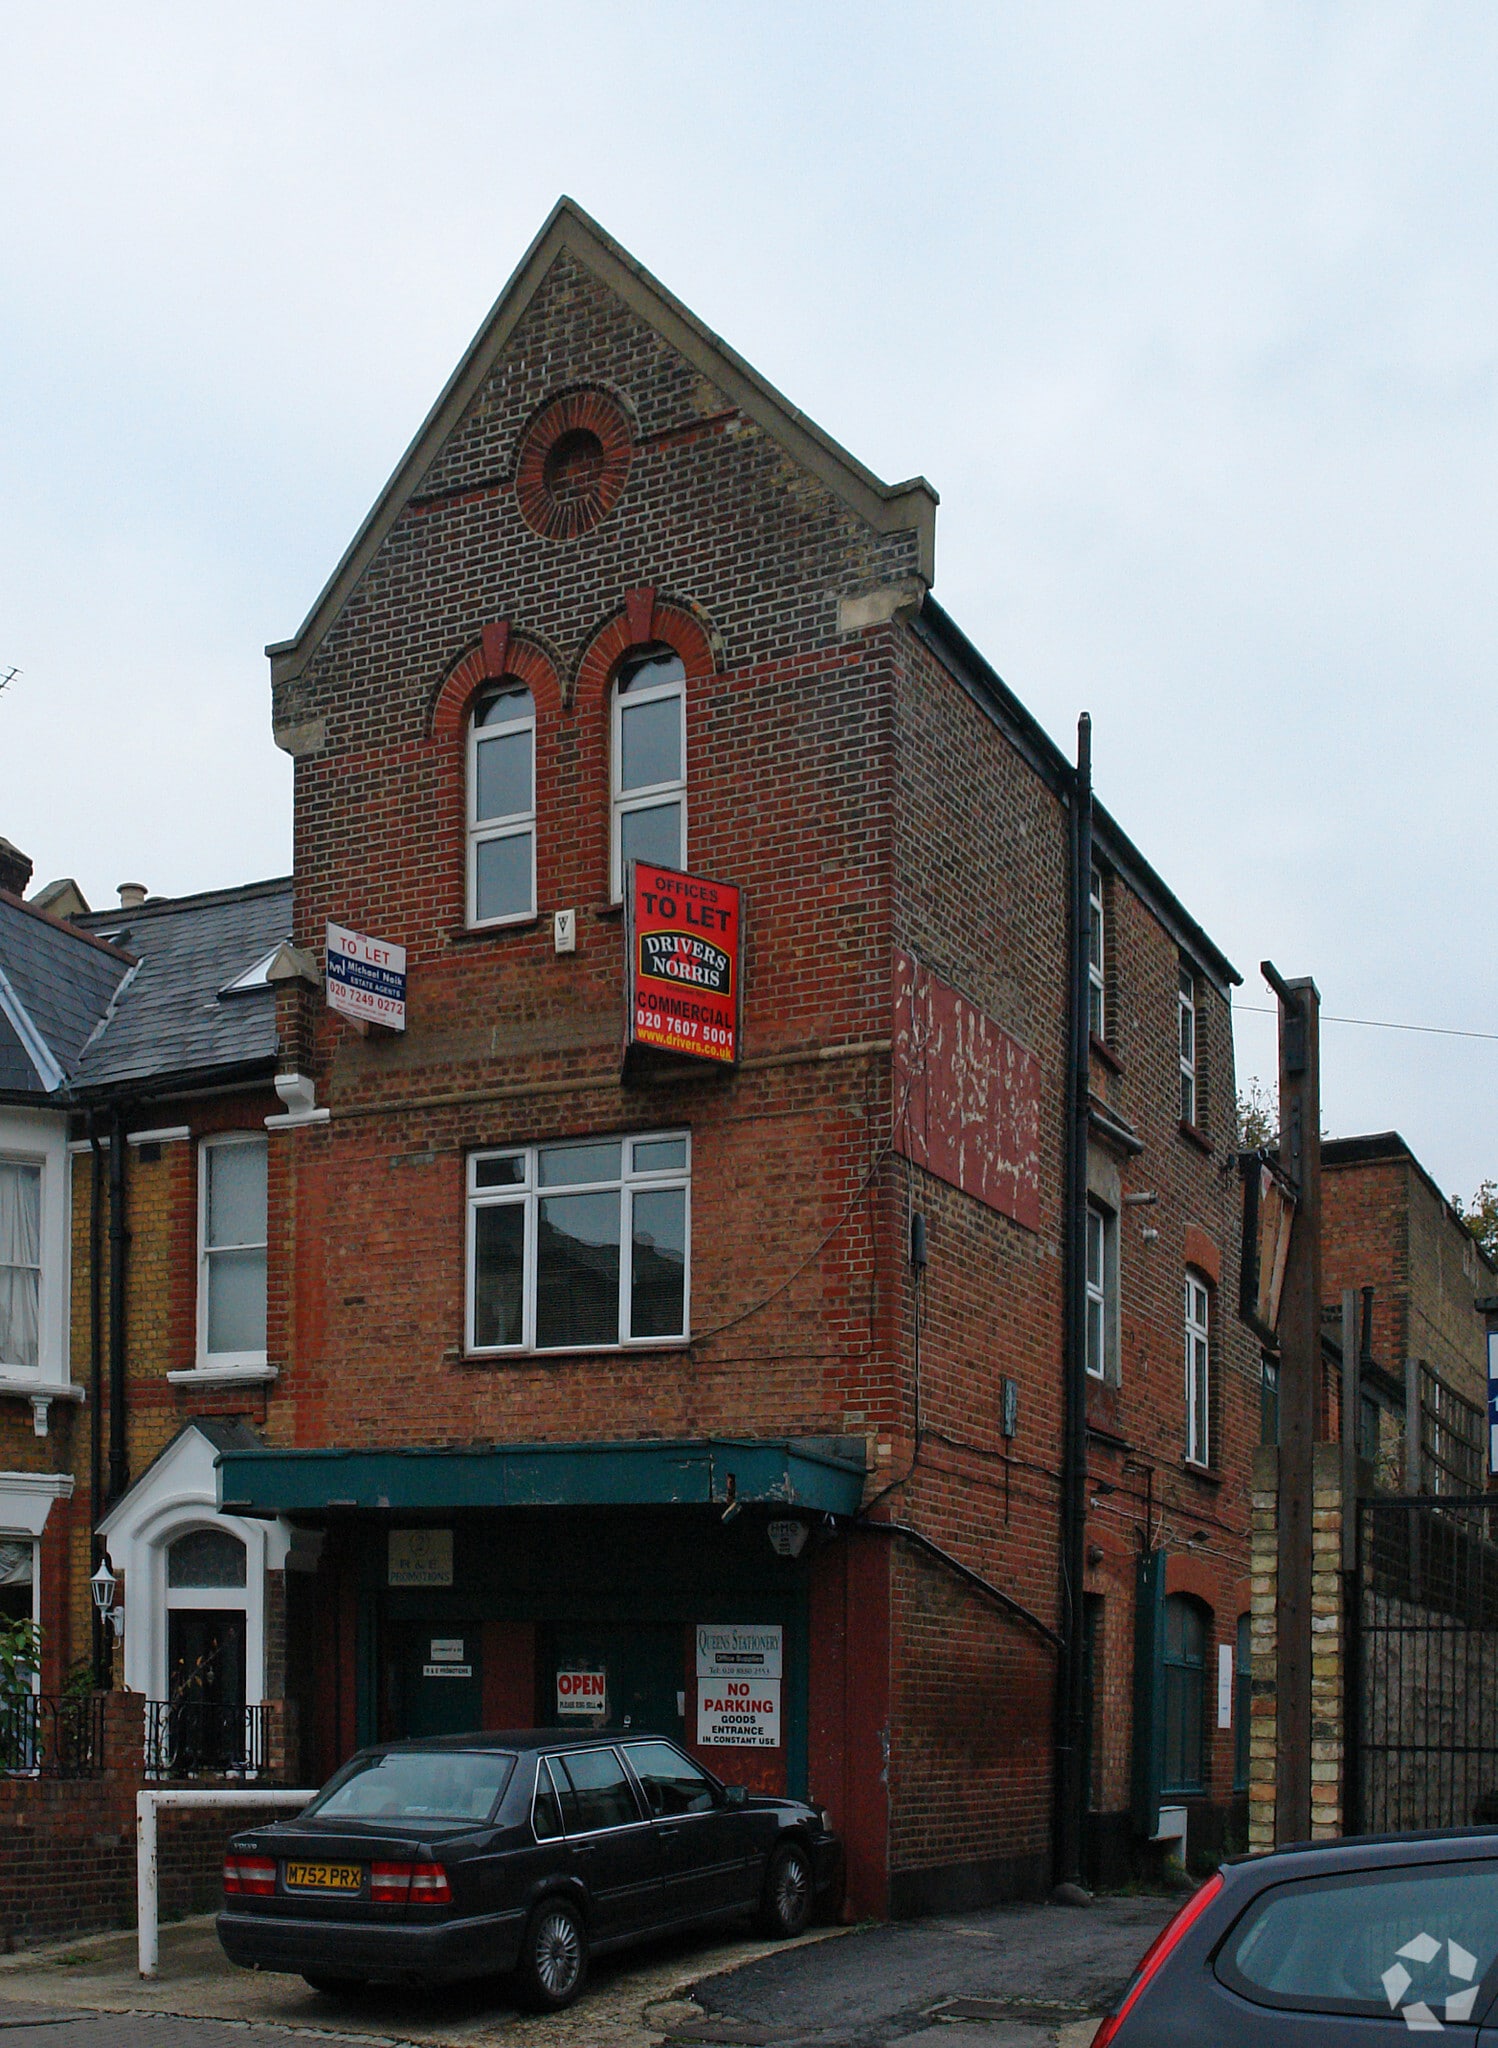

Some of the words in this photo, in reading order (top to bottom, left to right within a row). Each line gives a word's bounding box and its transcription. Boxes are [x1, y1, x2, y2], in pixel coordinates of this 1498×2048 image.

[655, 877, 718, 902] OFFICES
[641, 892, 677, 919] TO
[686, 901, 731, 931] LET
[340, 937, 357, 954] TO
[365, 946, 390, 965] LET
[645, 936, 726, 972] DRIVERS
[347, 961, 380, 979] Michael
[653, 955, 720, 987] NORRIS
[330, 981, 346, 997] 020
[349, 989, 374, 1006] 7249
[377, 998, 403, 1015] 0272
[350, 976, 374, 990] ESTATE
[374, 984, 401, 998] AGENTS
[637, 991, 732, 1029] COMMERCIAL
[637, 1010, 661, 1029] 020
[666, 1017, 698, 1037] 7607
[703, 1026, 732, 1046] 5001
[637, 1028, 732, 1059] www.drivers.co.uk
[732, 1629, 779, 1651] STATIONERY
[559, 1674, 604, 1695] OPEN
[728, 1683, 750, 1696] NO
[704, 1698, 773, 1713] PARKING
[712, 1725, 764, 1735] ENTRANCE
[721, 1715, 756, 1724] GOODS
[713, 1736, 757, 1744] CONSTANT
[759, 1737, 775, 1745] USE
[288, 1866, 327, 1884] M752
[330, 1868, 360, 1886] PRX
